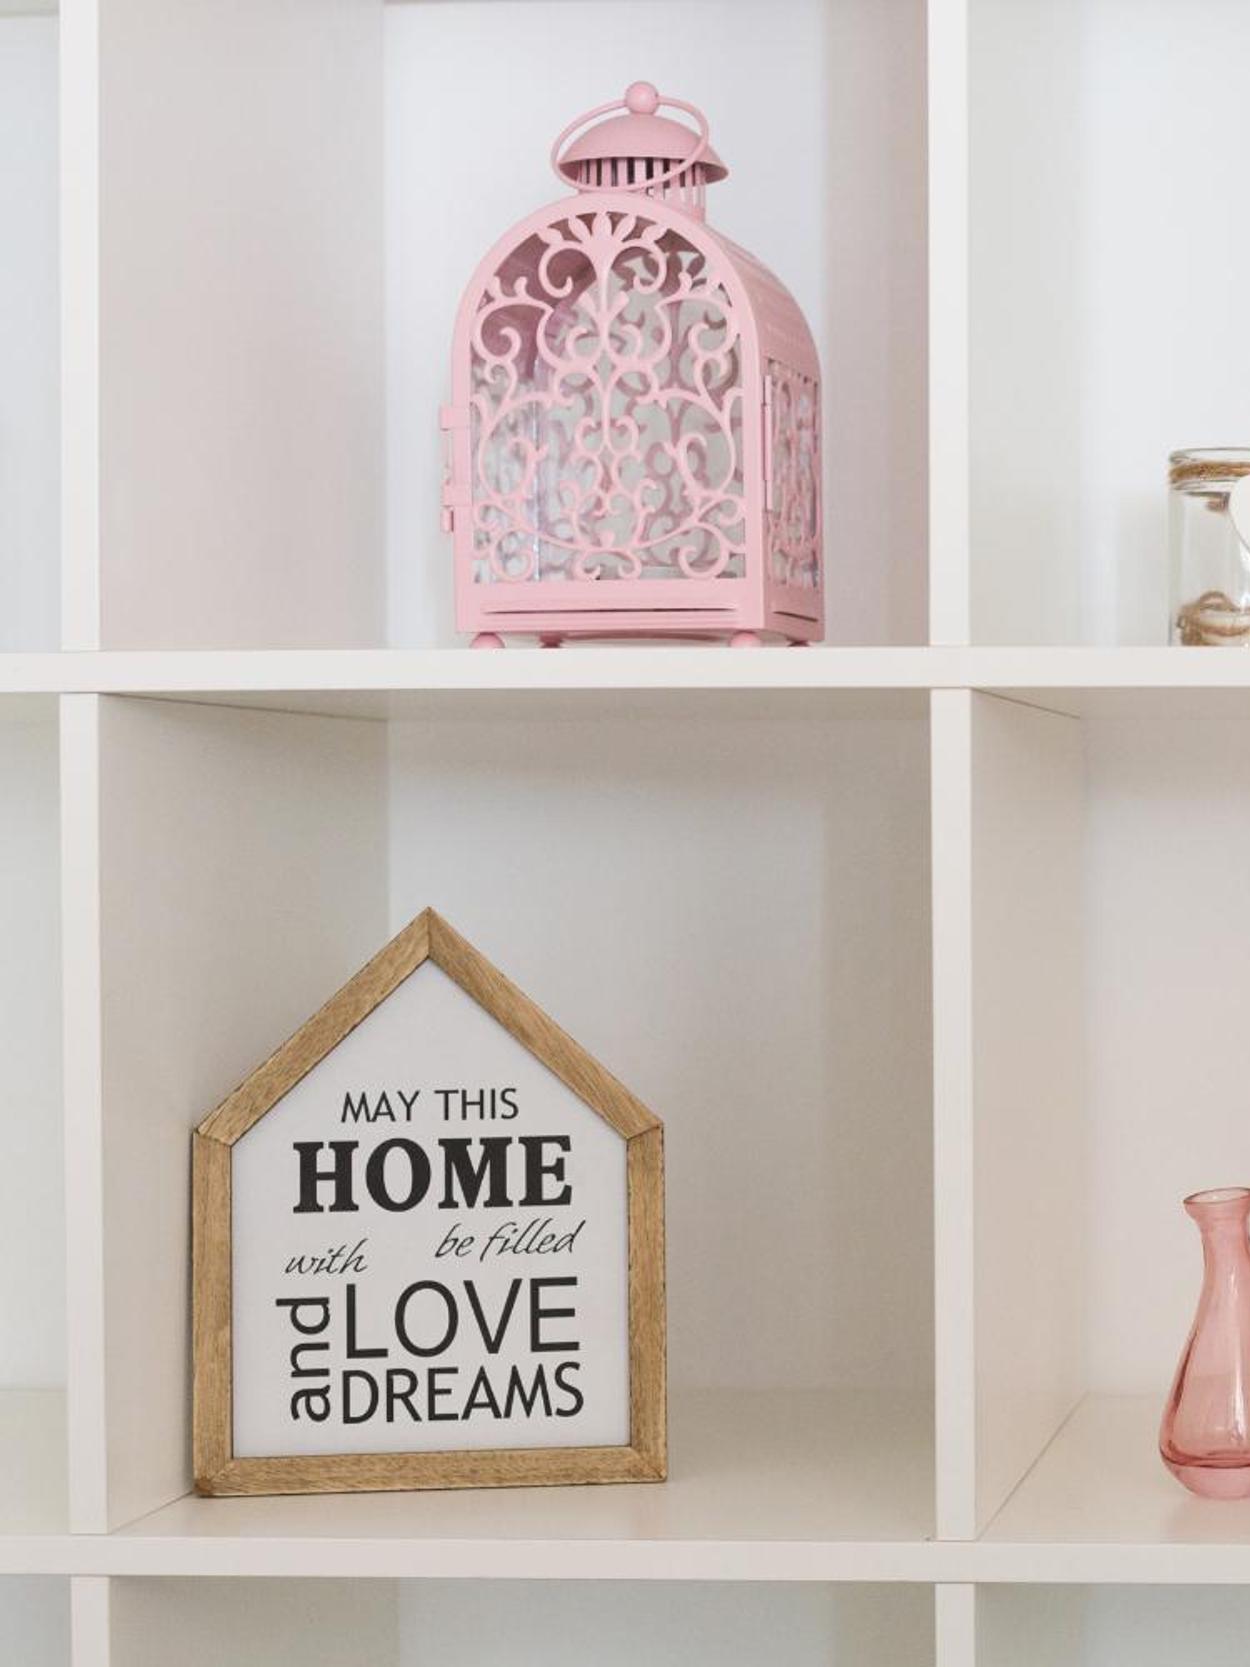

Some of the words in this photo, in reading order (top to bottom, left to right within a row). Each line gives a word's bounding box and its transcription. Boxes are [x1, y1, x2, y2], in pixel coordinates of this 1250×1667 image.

[341, 1089, 420, 1123] MAY
[434, 1087, 519, 1121] THIS
[292, 1135, 573, 1213] HOME
[284, 1238, 368, 1275] with
[434, 1221, 474, 1258] be
[480, 1218, 586, 1262] filled
[346, 1276, 580, 1360] LOVE
[275, 1296, 331, 1423] and
[342, 1361, 584, 1425] DREAMS
